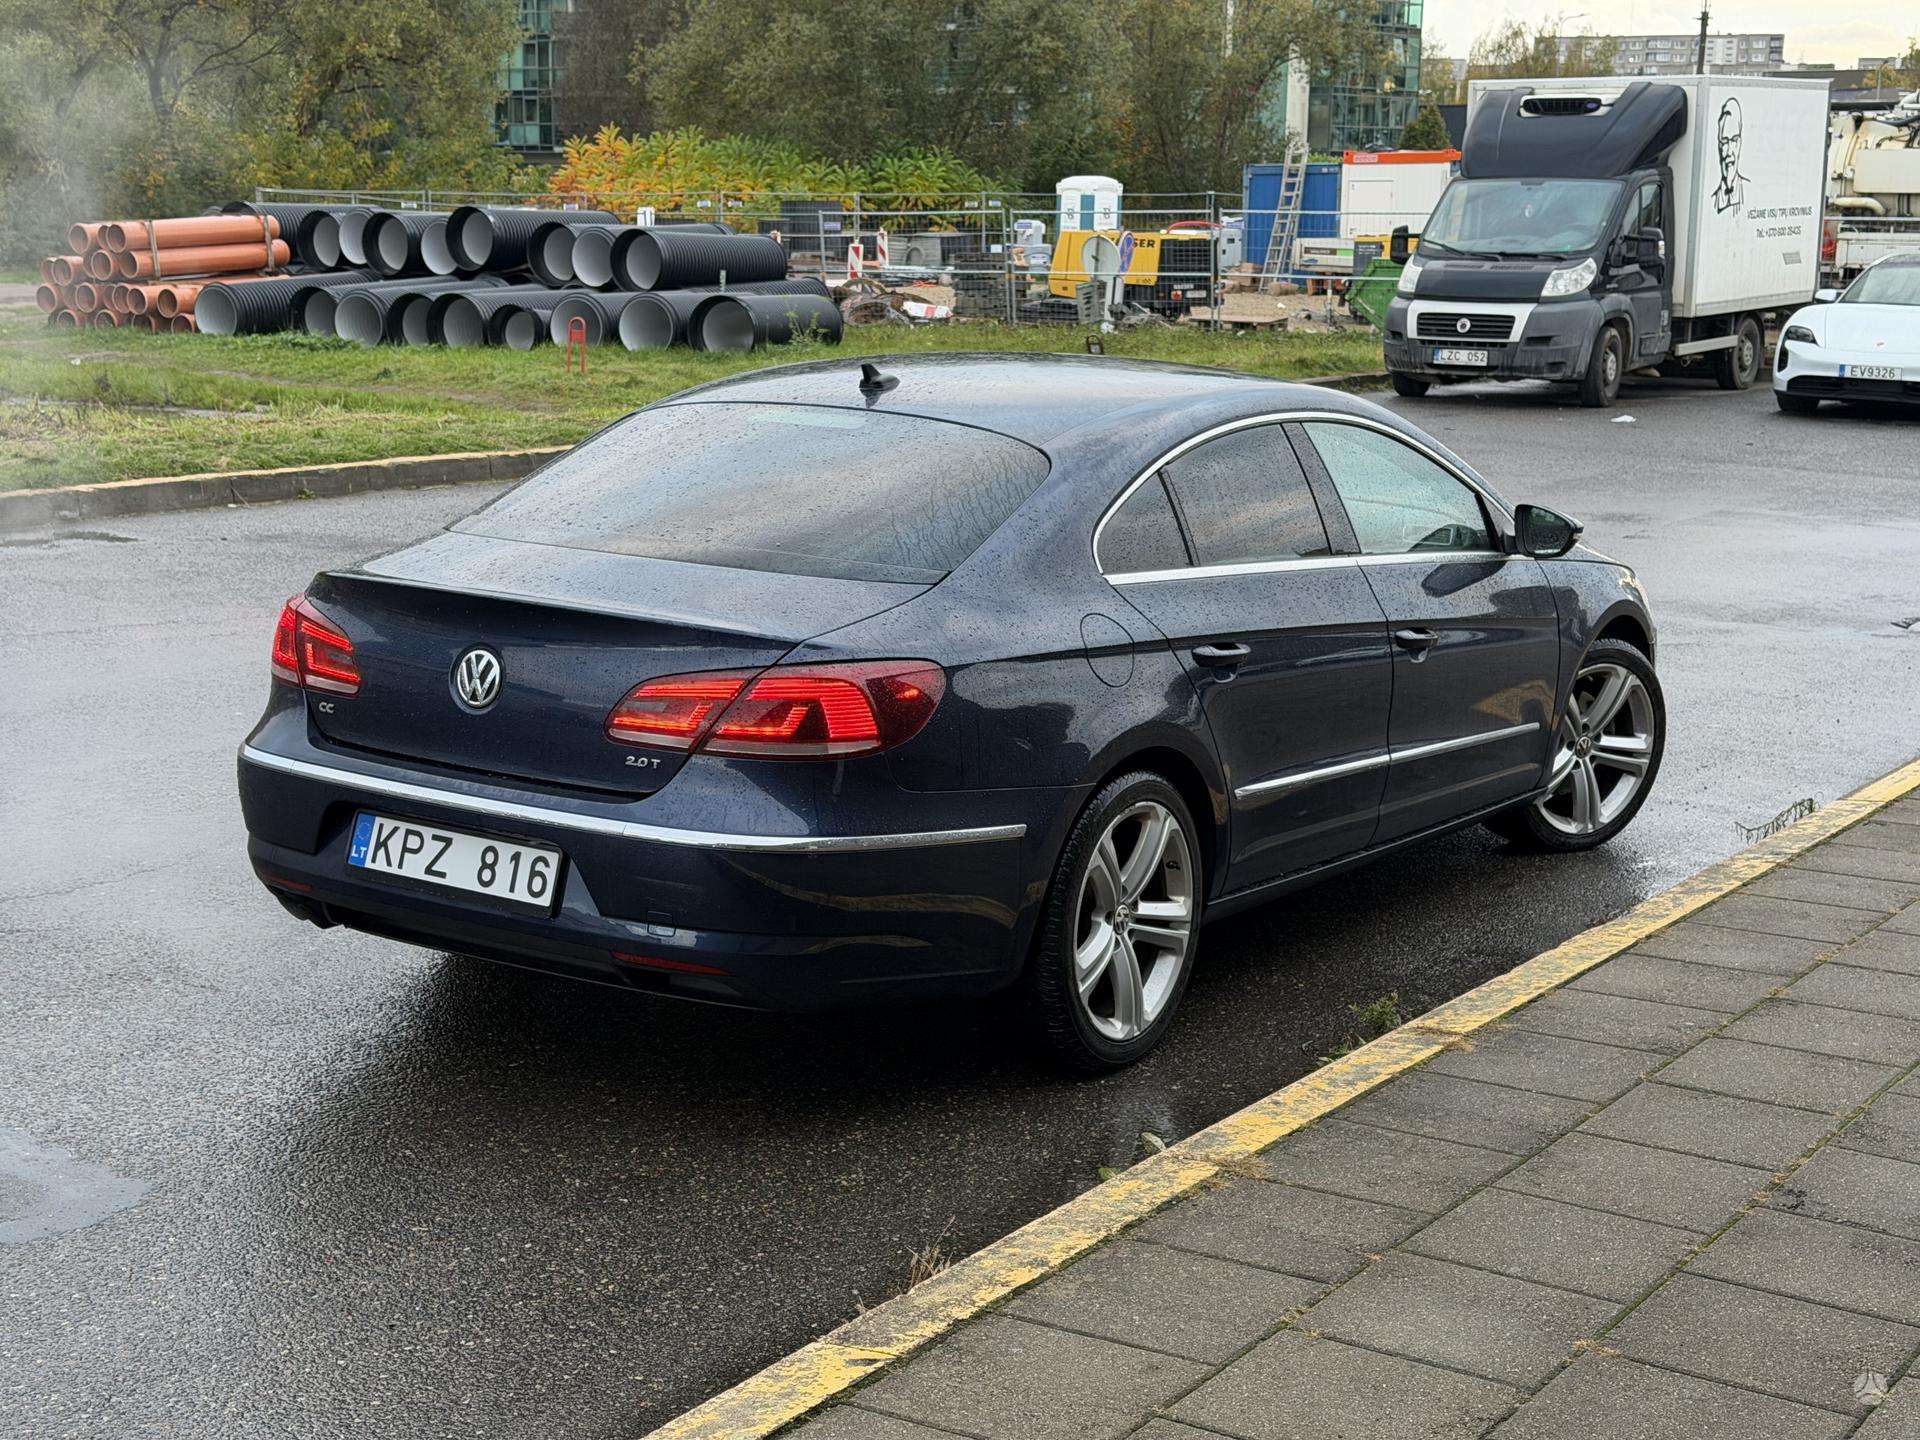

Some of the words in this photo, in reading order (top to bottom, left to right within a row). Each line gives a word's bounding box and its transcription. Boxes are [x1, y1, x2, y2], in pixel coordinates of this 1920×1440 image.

[1441, 350, 1460, 361] LZC
[1468, 351, 1486, 362] 052
[1851, 365, 1895, 378] EV9326
[318, 701, 335, 714] CC
[351, 844, 367, 858] LT
[371, 823, 453, 879] KPZ
[477, 845, 550, 899] 816
